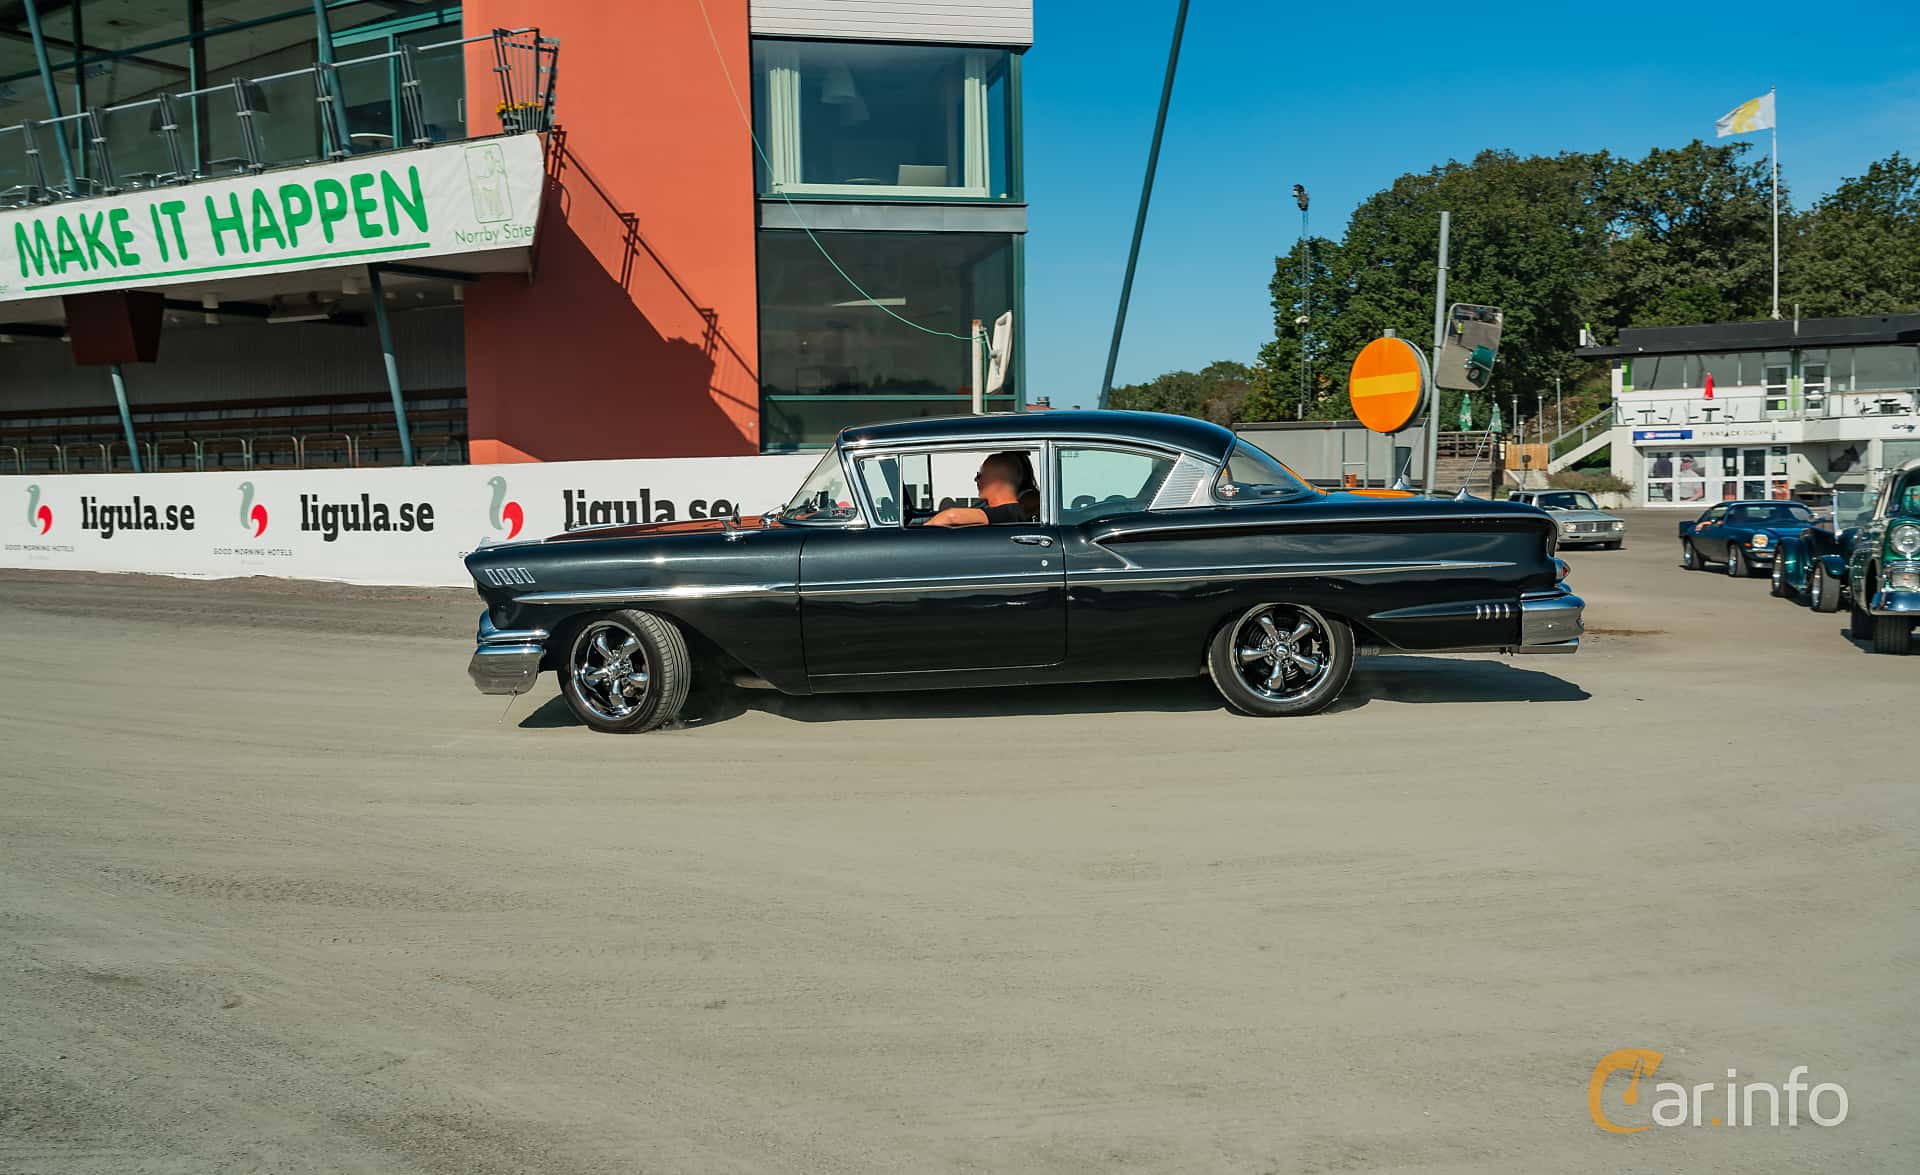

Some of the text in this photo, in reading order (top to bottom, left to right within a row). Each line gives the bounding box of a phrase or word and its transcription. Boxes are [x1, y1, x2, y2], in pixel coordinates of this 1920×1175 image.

[14, 165, 430, 278] MAKE IT HAPPEN
[81, 495, 195, 540] ligula.se
[300, 493, 435, 543] ligula.se
